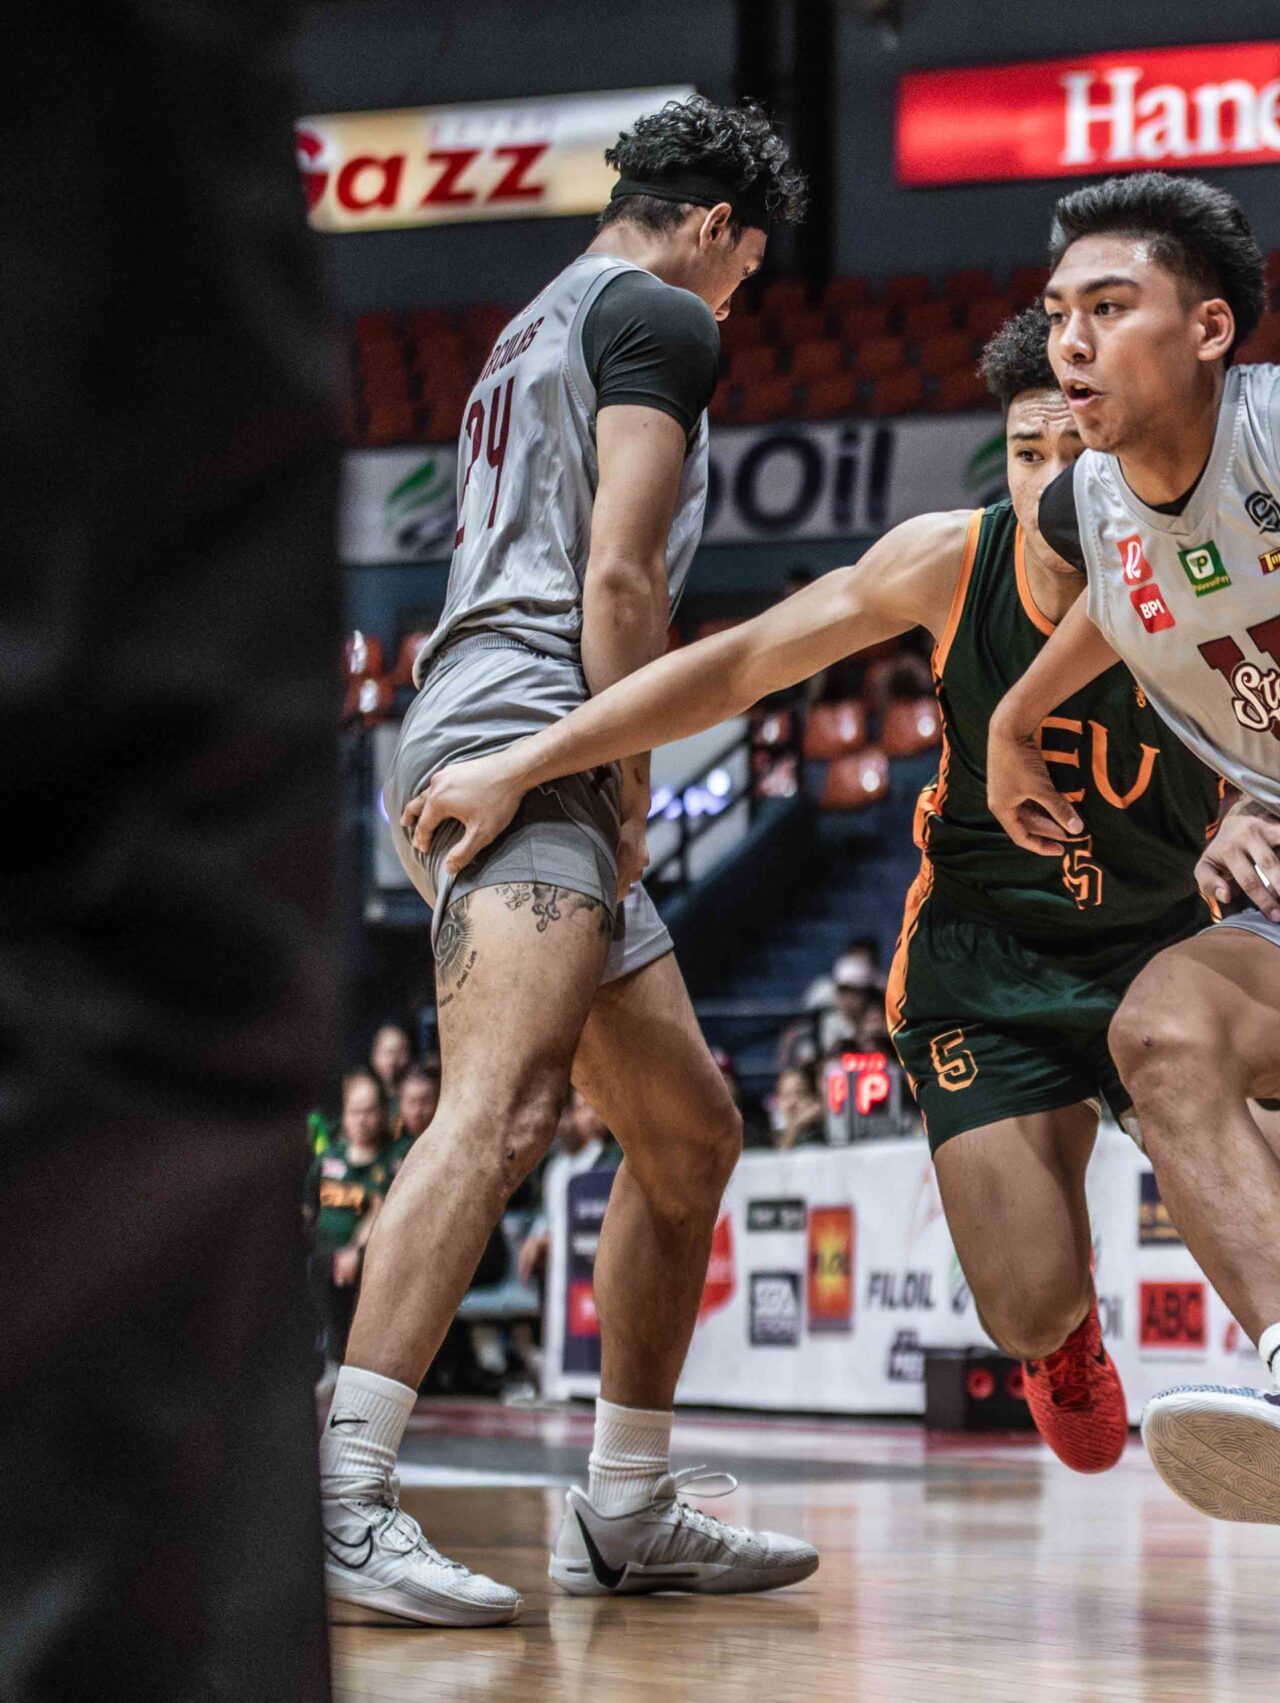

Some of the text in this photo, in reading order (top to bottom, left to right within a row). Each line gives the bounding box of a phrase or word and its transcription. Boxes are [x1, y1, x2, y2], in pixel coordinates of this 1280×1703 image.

[1139, 598, 1165, 620] BPI
[1062, 834, 1104, 911] 5
[930, 1028, 979, 1092] 5
[868, 1270, 934, 1310] FILOIL
